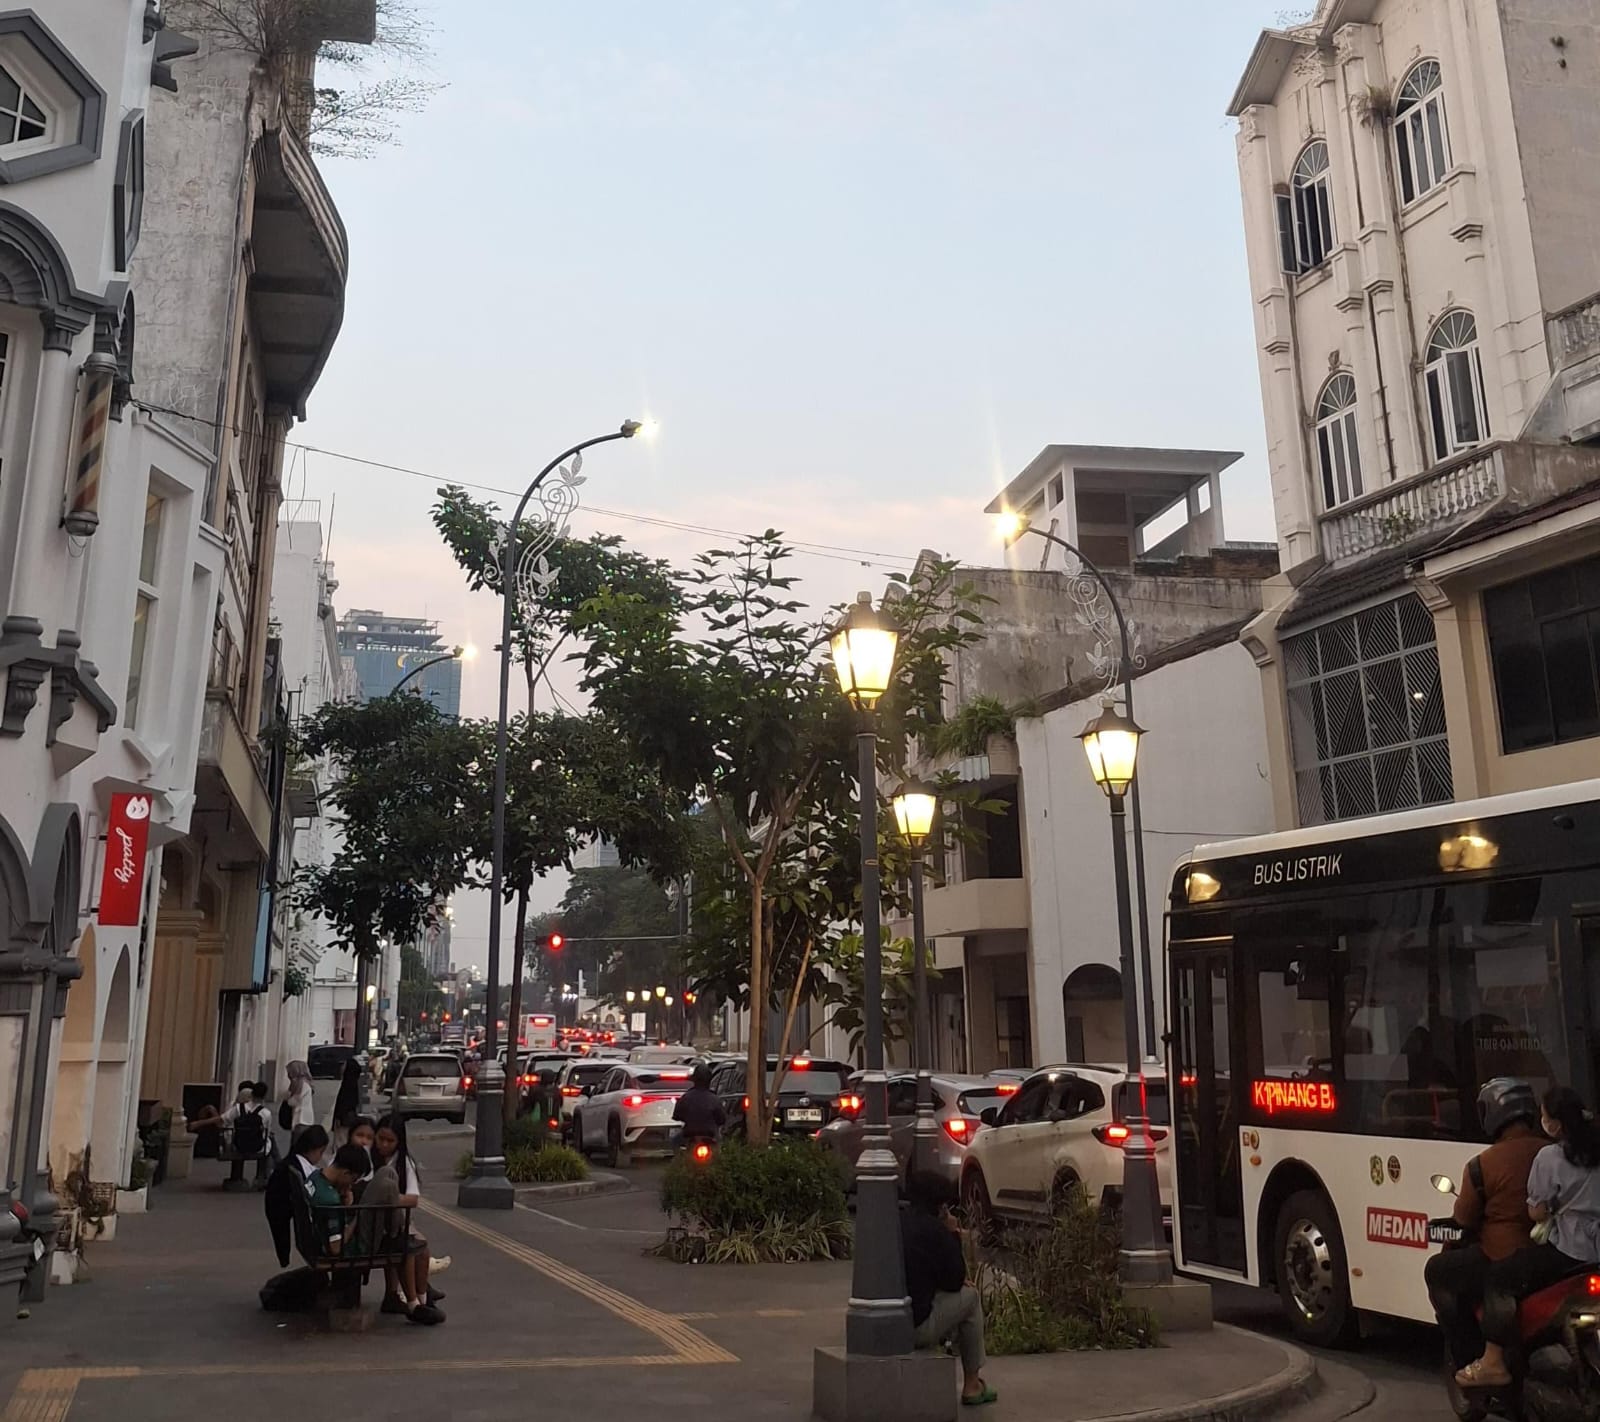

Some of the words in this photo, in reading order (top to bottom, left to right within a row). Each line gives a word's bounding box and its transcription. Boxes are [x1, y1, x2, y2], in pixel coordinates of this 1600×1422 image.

[1254, 861, 1284, 885] BUS
[1286, 853, 1342, 882] LISTRIK
[1368, 1212, 1427, 1243] MEDAN
